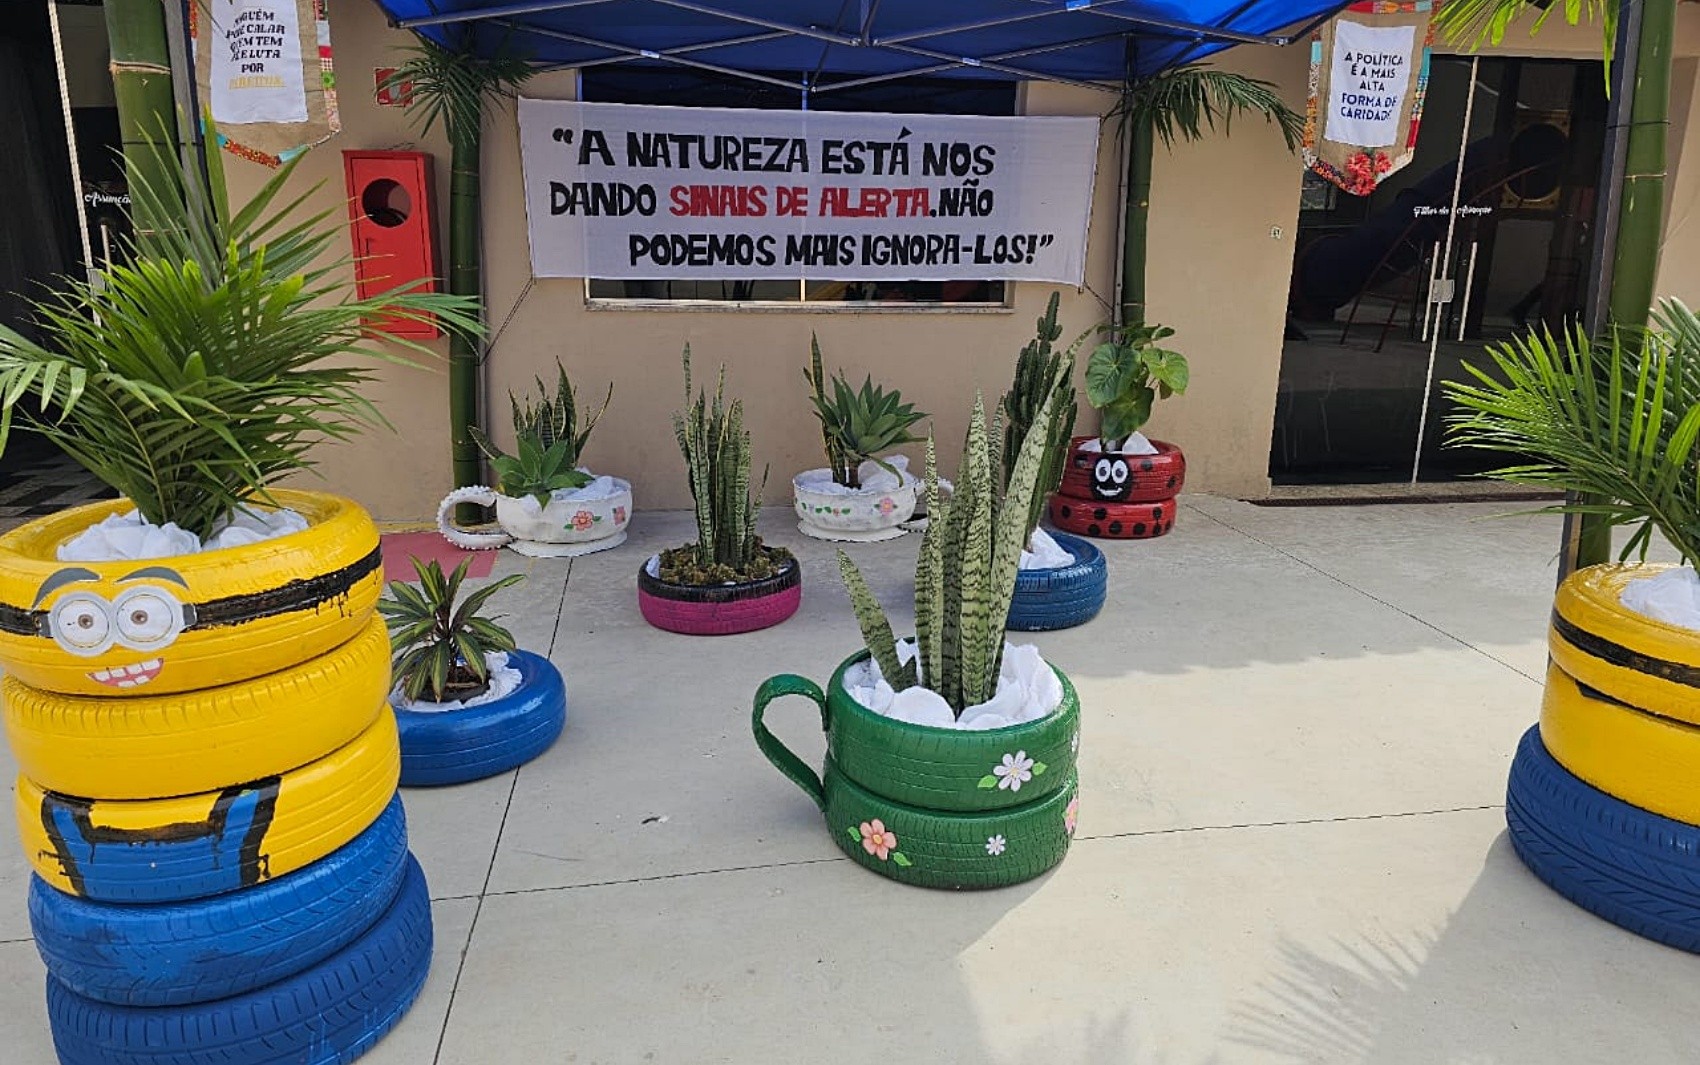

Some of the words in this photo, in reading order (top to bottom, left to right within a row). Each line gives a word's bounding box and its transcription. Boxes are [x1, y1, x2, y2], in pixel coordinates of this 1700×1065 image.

[246, 24, 285, 34] CALAR
[255, 36, 283, 46] TEM
[249, 49, 281, 58] LUTA
[1344, 51, 1353, 61] A
[1356, 52, 1403, 66] POLÍTICA
[241, 62, 264, 73] POR
[1351, 63, 1358, 75] É
[1360, 67, 1368, 77] A
[1371, 68, 1395, 78] MAIS
[1359, 80, 1385, 91] ALTA
[1342, 93, 1381, 107] FORMA
[626, 131, 809, 172] NATUREZA
[821, 126, 913, 176] ESTÁ
[922, 142, 996, 176] NOS
[549, 181, 657, 217] DANDO
[669, 184, 767, 217] SINAIS
[776, 186, 808, 217] DE
[628, 233, 776, 266] PODEMOS
[784, 233, 856, 266] MAIS
